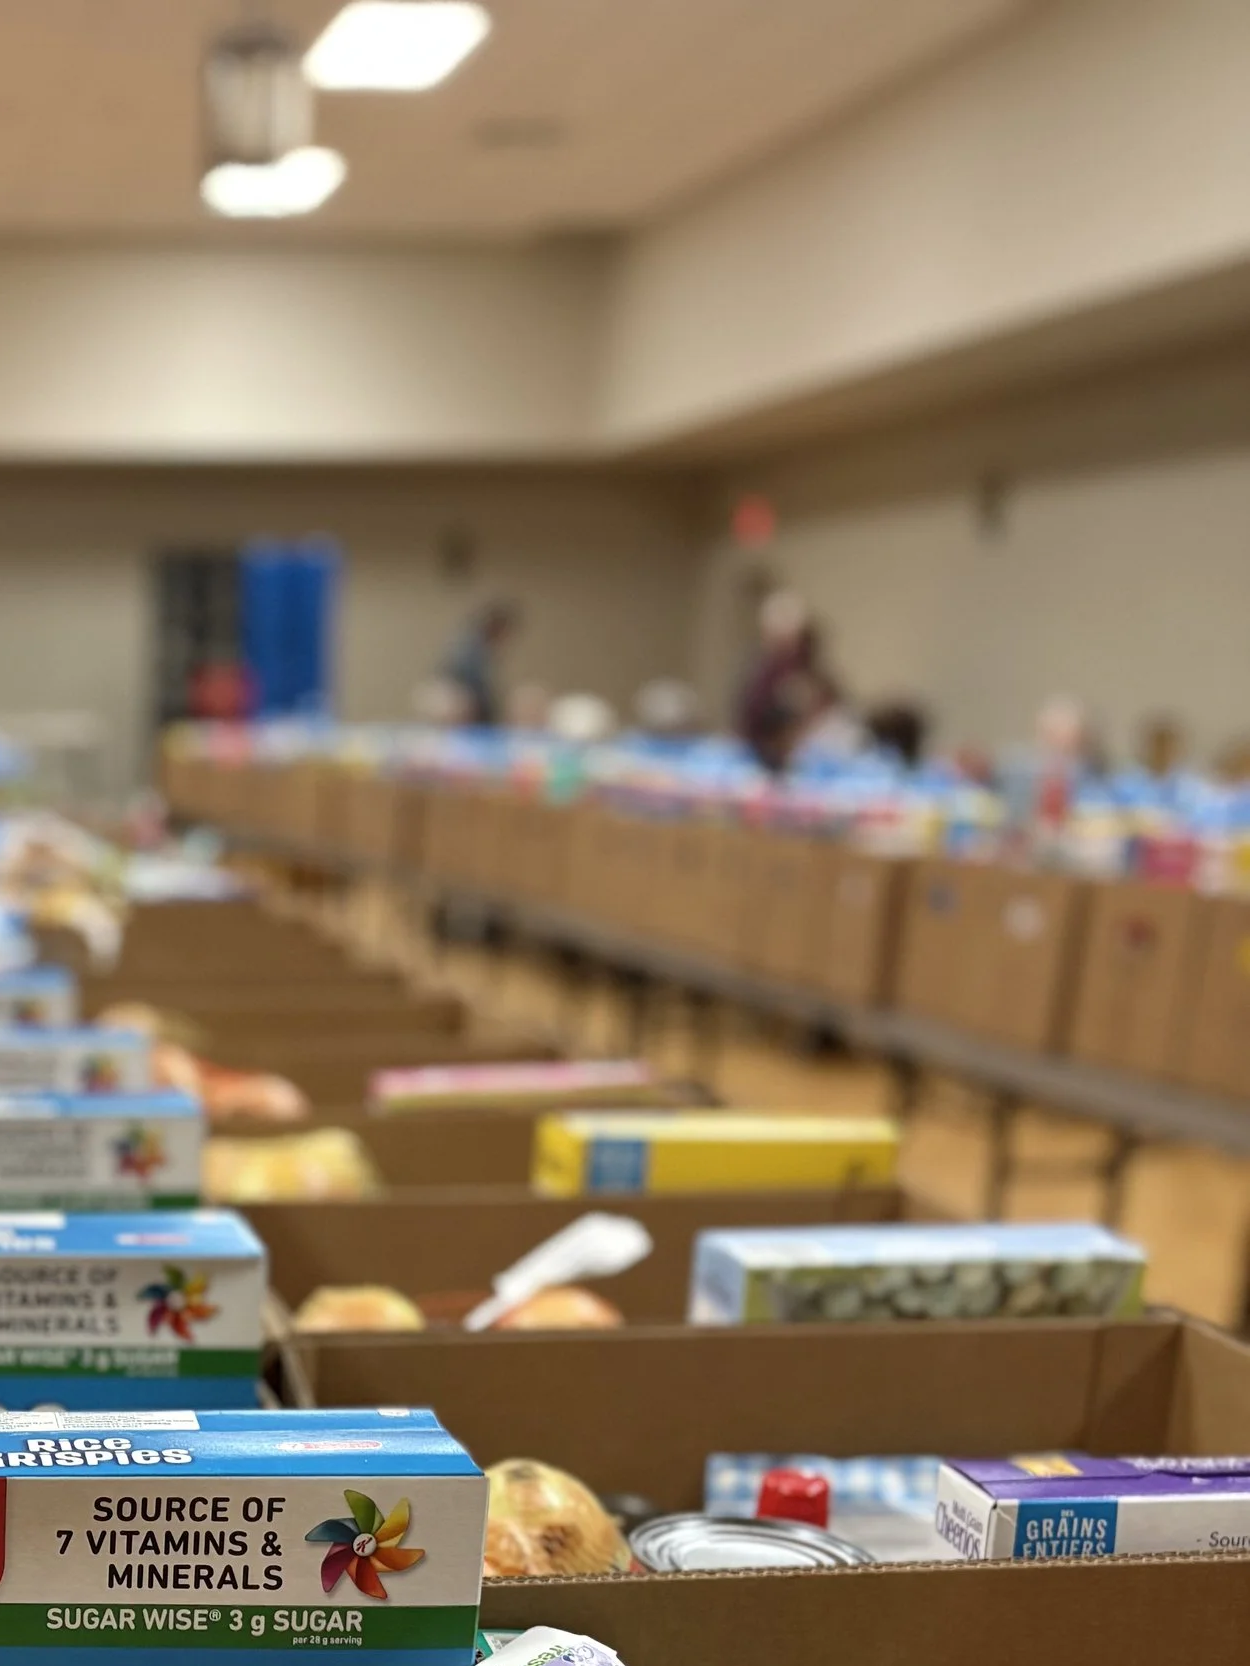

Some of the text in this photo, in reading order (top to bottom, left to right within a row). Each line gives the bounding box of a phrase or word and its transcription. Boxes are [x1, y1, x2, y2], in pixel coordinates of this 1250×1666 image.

[87, 1266, 119, 1286] OF
[93, 1497, 287, 1524] SOURCE OF
[935, 1501, 981, 1559] Cheerios
[1025, 1518, 1108, 1541] GRAINS
[1208, 1531, 1250, 1548] Sour
[56, 1531, 283, 1557] 7 VITAMINS &
[1022, 1540, 1106, 1557] ENTIERS
[107, 1563, 284, 1591] MINERALS
[46, 1609, 138, 1632] SUGAR
[228, 1610, 245, 1633] 3
[250, 1616, 266, 1638] g
[272, 1610, 364, 1634] SUGAR
[292, 1639, 308, 1647] per
[310, 1637, 323, 1646] 28
[331, 1638, 363, 1648] serving
